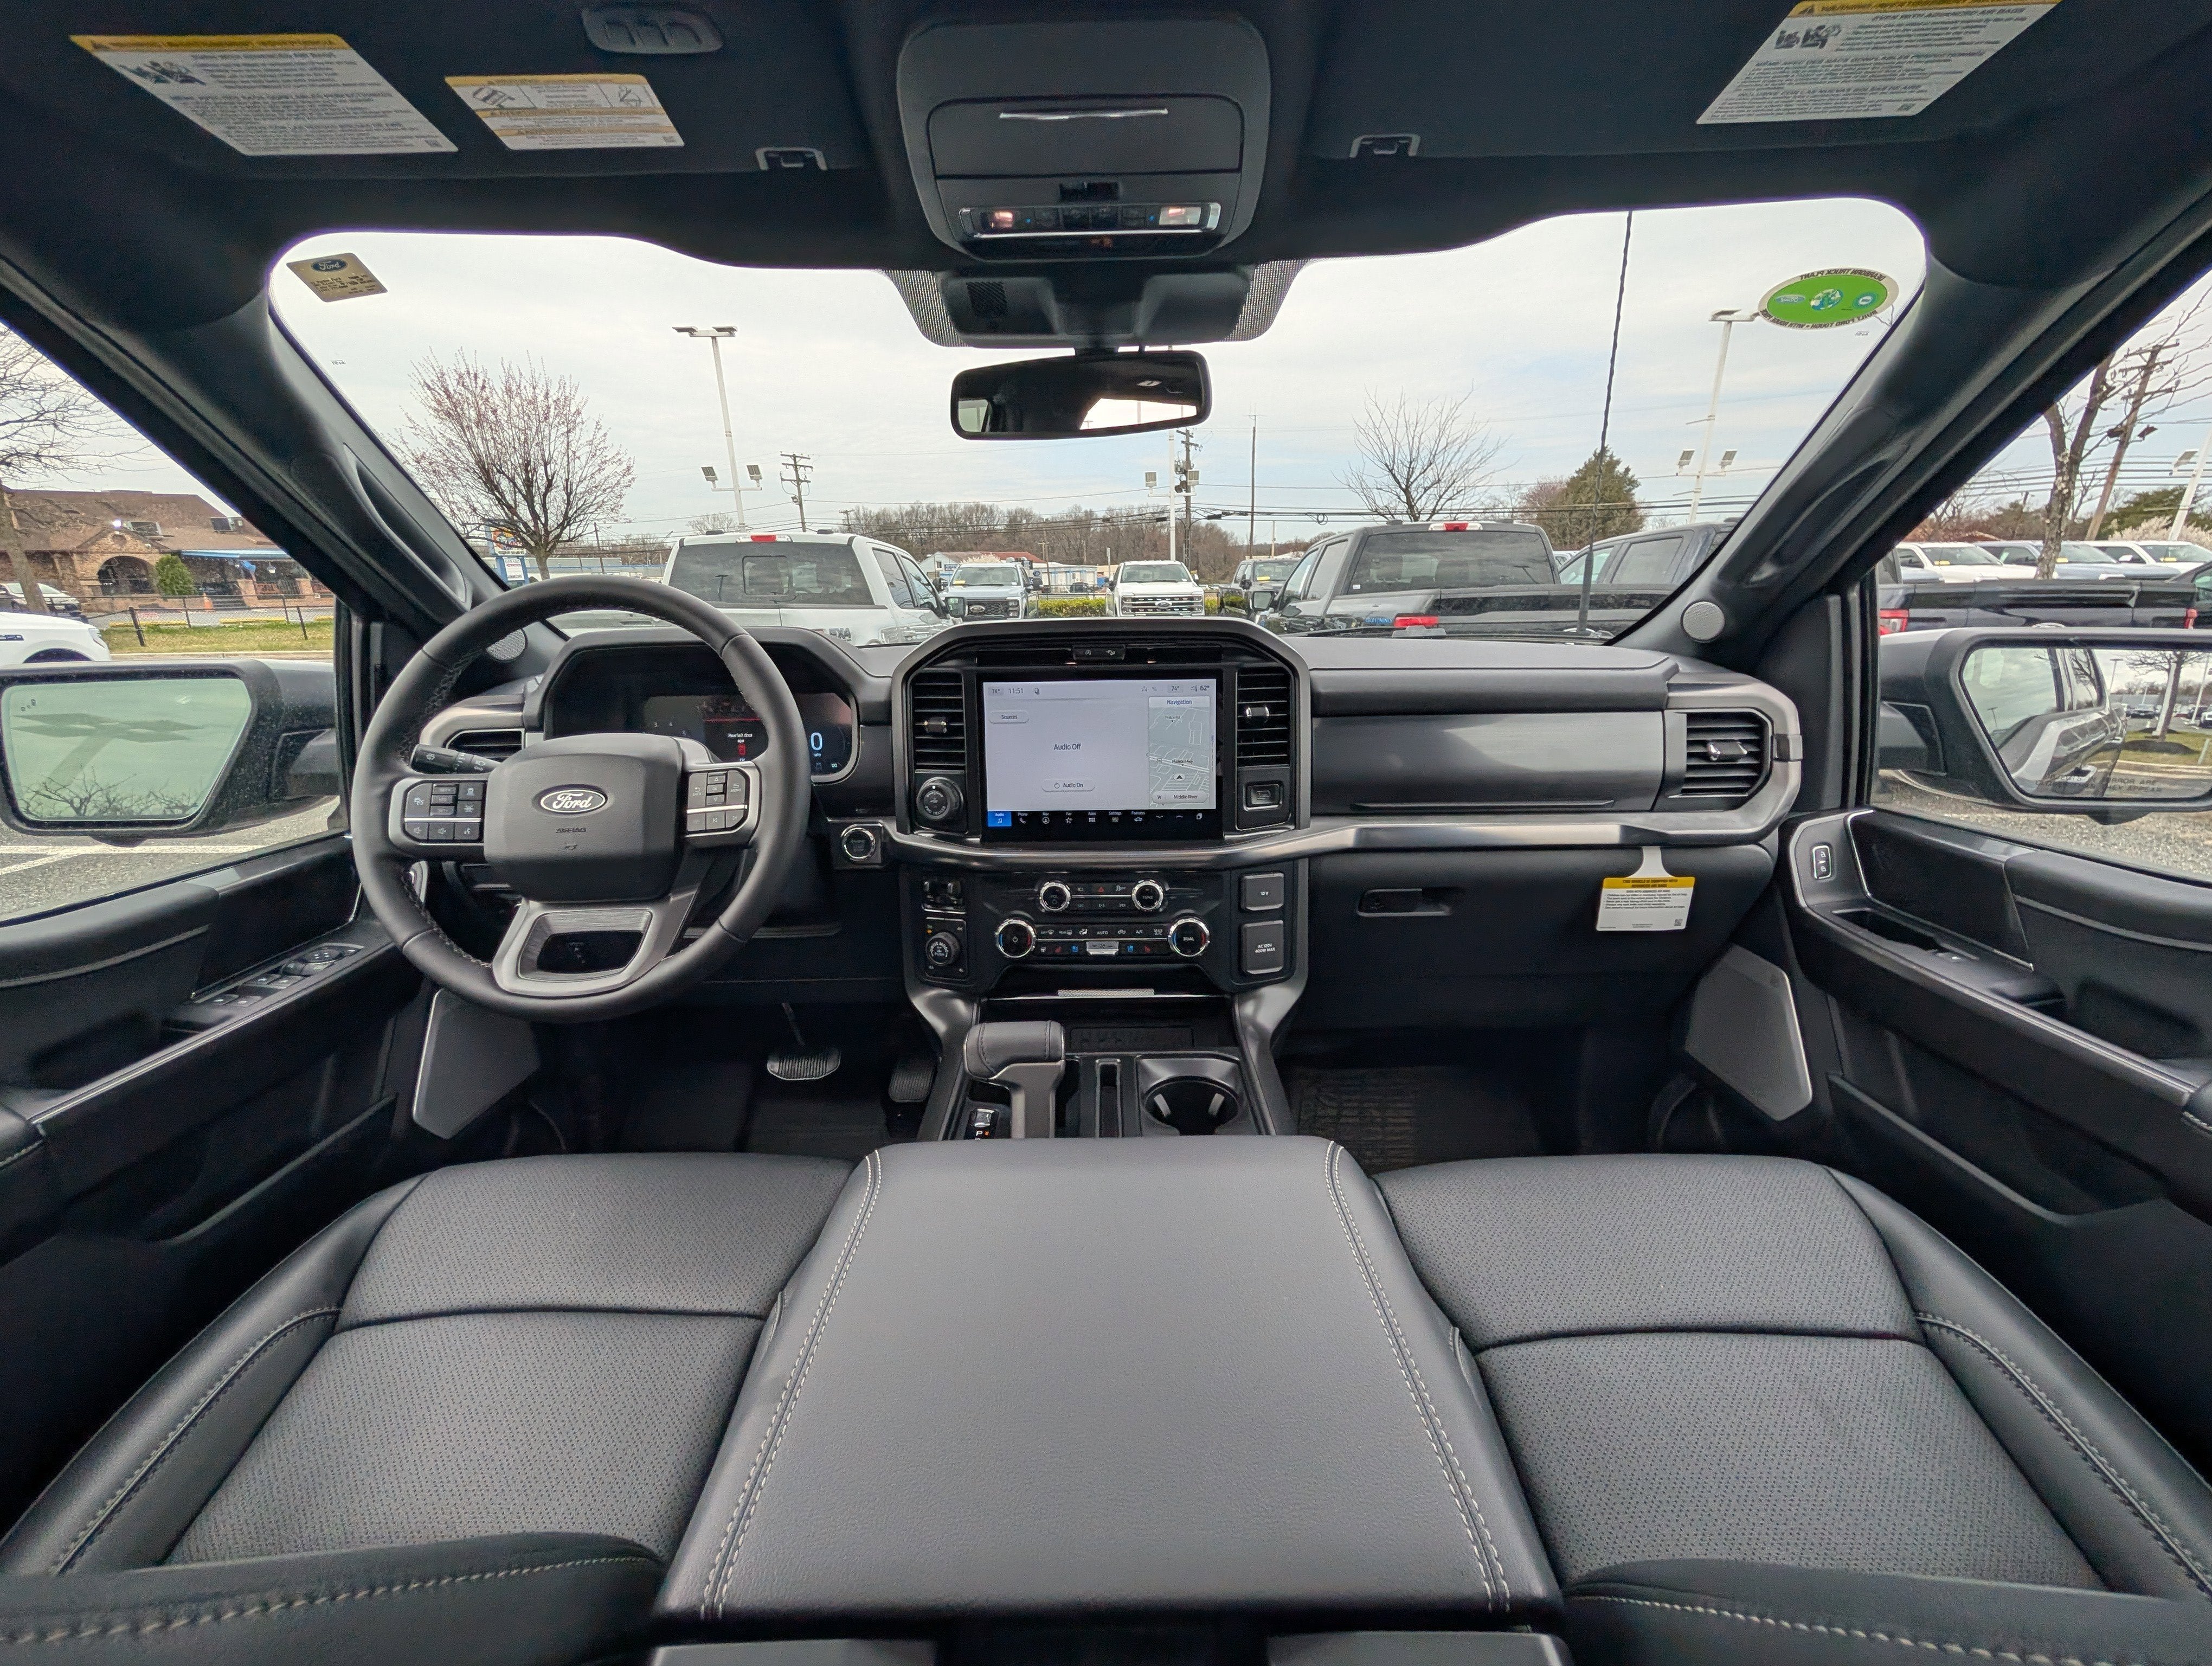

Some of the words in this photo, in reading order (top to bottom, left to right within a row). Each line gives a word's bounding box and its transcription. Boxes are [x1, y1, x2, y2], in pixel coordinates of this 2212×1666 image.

[319, 261, 340, 270] Ford
[811, 732, 822, 751] 0
[552, 793, 593, 809] Ford
